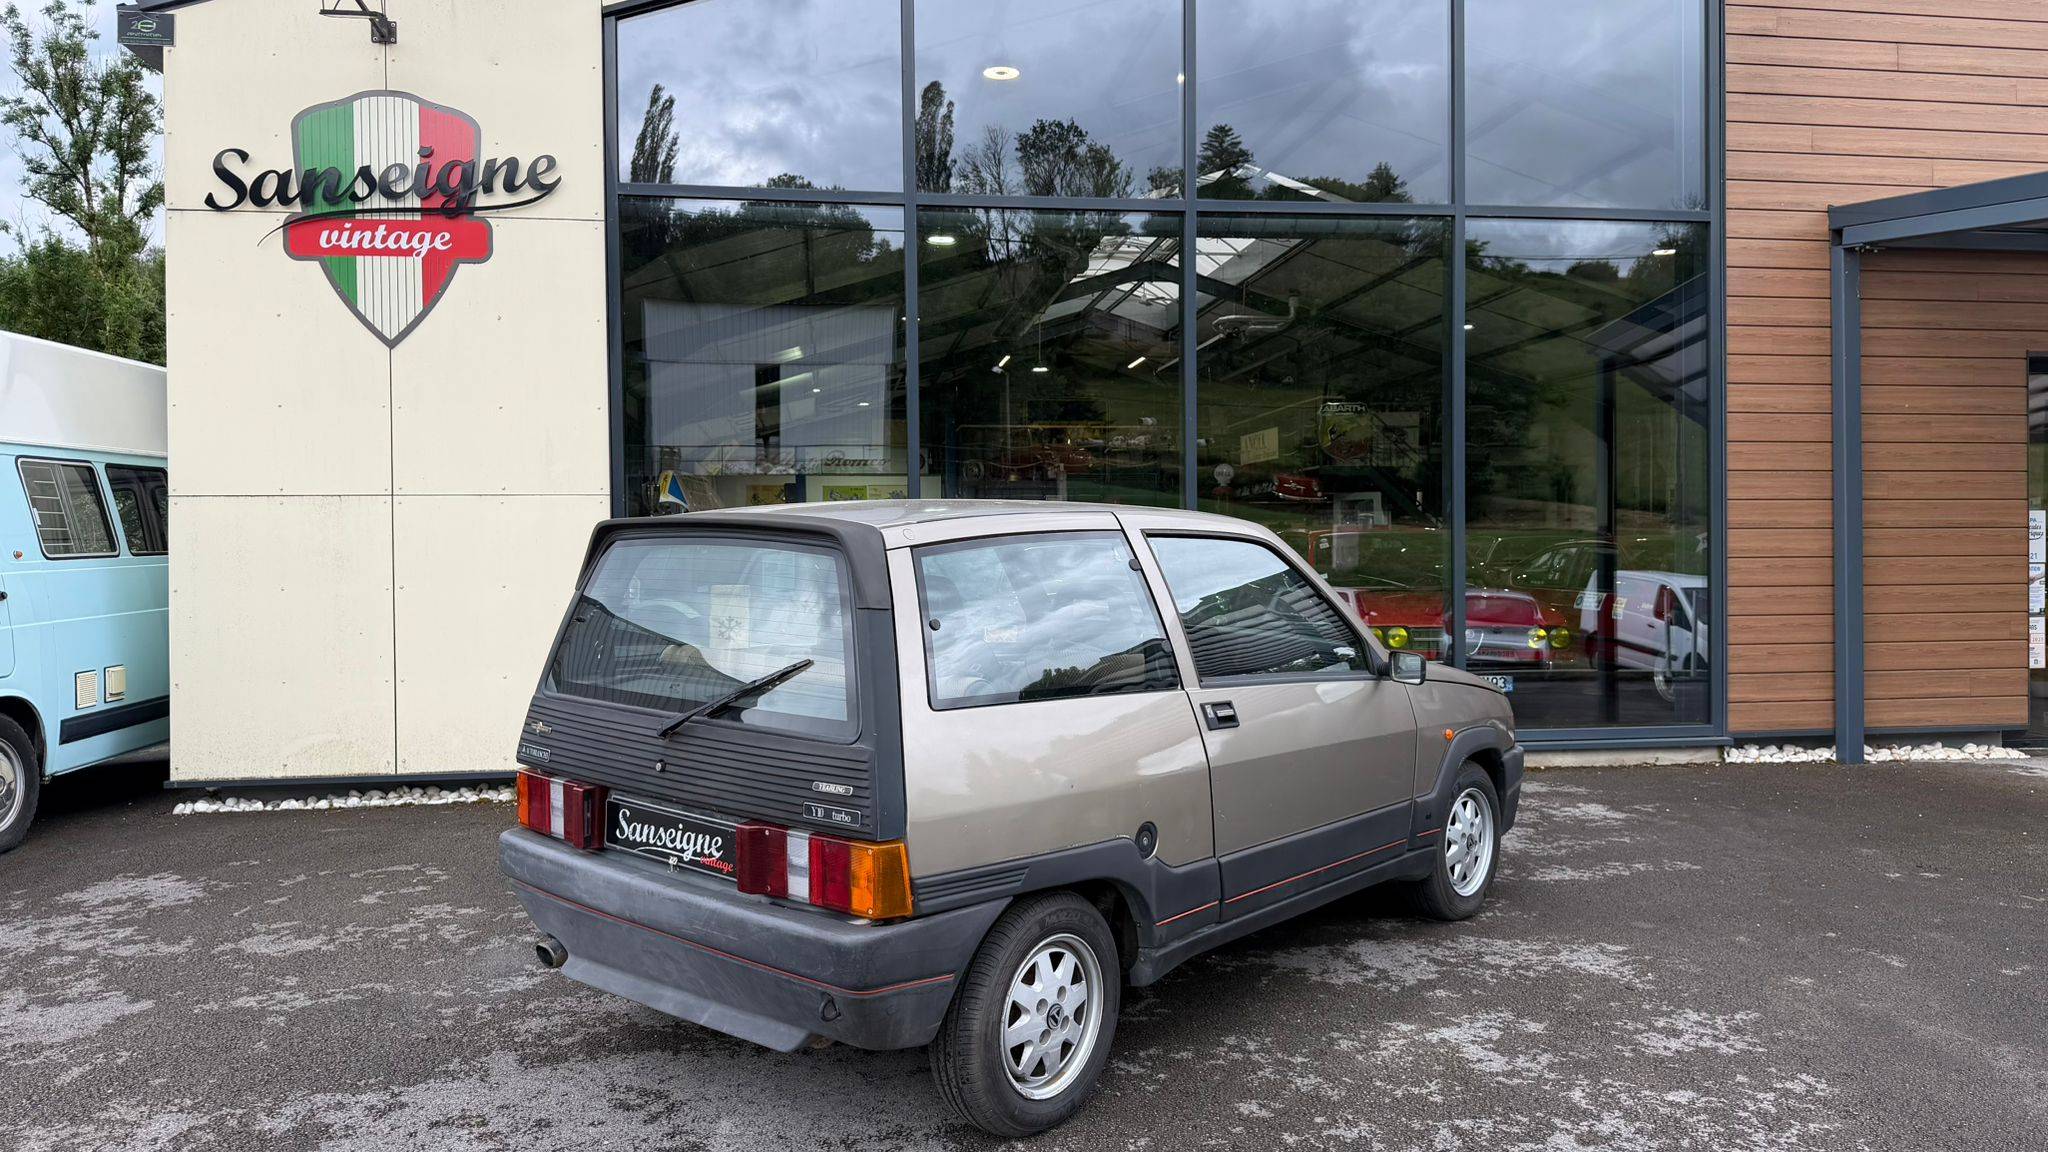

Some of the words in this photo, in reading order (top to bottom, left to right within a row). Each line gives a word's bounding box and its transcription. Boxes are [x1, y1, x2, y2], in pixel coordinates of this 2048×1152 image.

[204, 146, 562, 219] Sanseigne
[319, 223, 453, 258] vintage
[1323, 403, 1366, 413] ABARTH
[811, 806, 825, 818] Y10
[831, 811, 851, 823] turbo
[616, 808, 724, 862] Sanseigne
